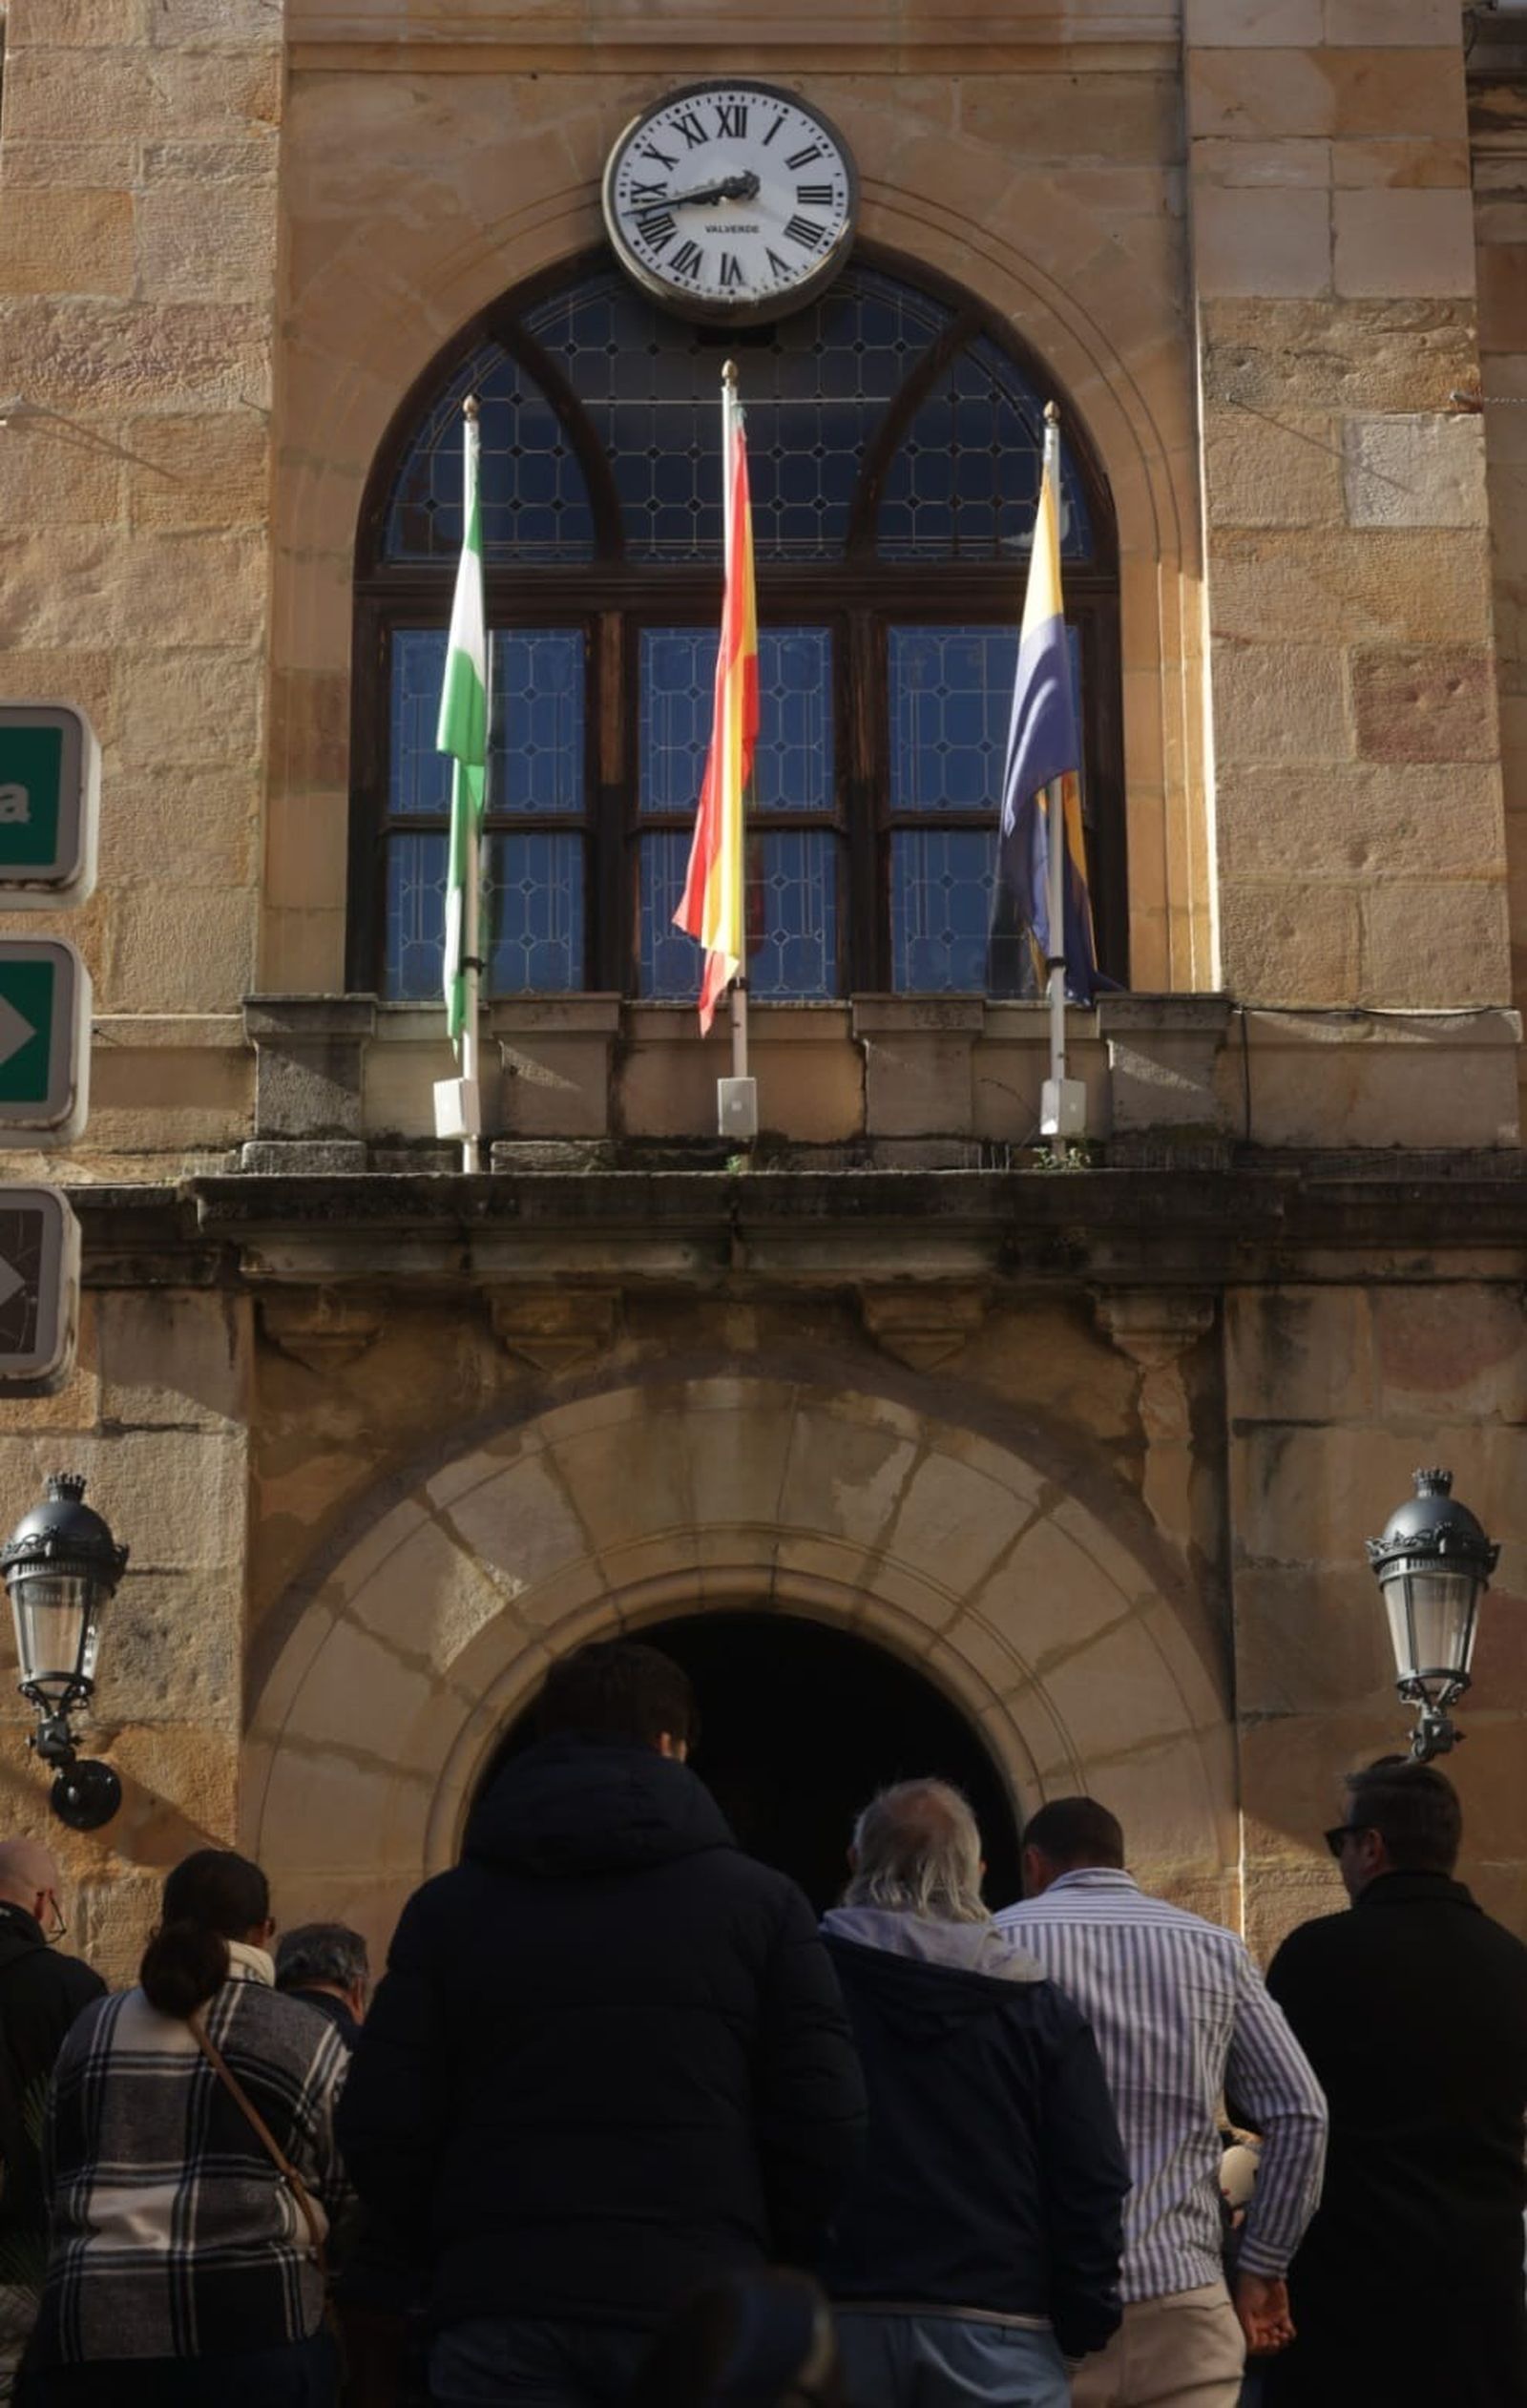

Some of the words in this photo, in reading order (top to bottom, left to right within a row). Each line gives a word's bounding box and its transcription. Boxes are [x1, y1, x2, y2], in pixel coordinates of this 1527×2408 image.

[670, 113, 709, 149] XI
[716, 105, 748, 138] XII
[641, 143, 680, 171] X
[784, 144, 823, 170] II
[630, 181, 668, 204] IX
[796, 185, 833, 205] III
[705, 224, 761, 234] VALVERDE
[784, 215, 826, 249] IIII
[669, 240, 704, 280] VII
[719, 252, 746, 286] VI
[765, 247, 791, 278] V
